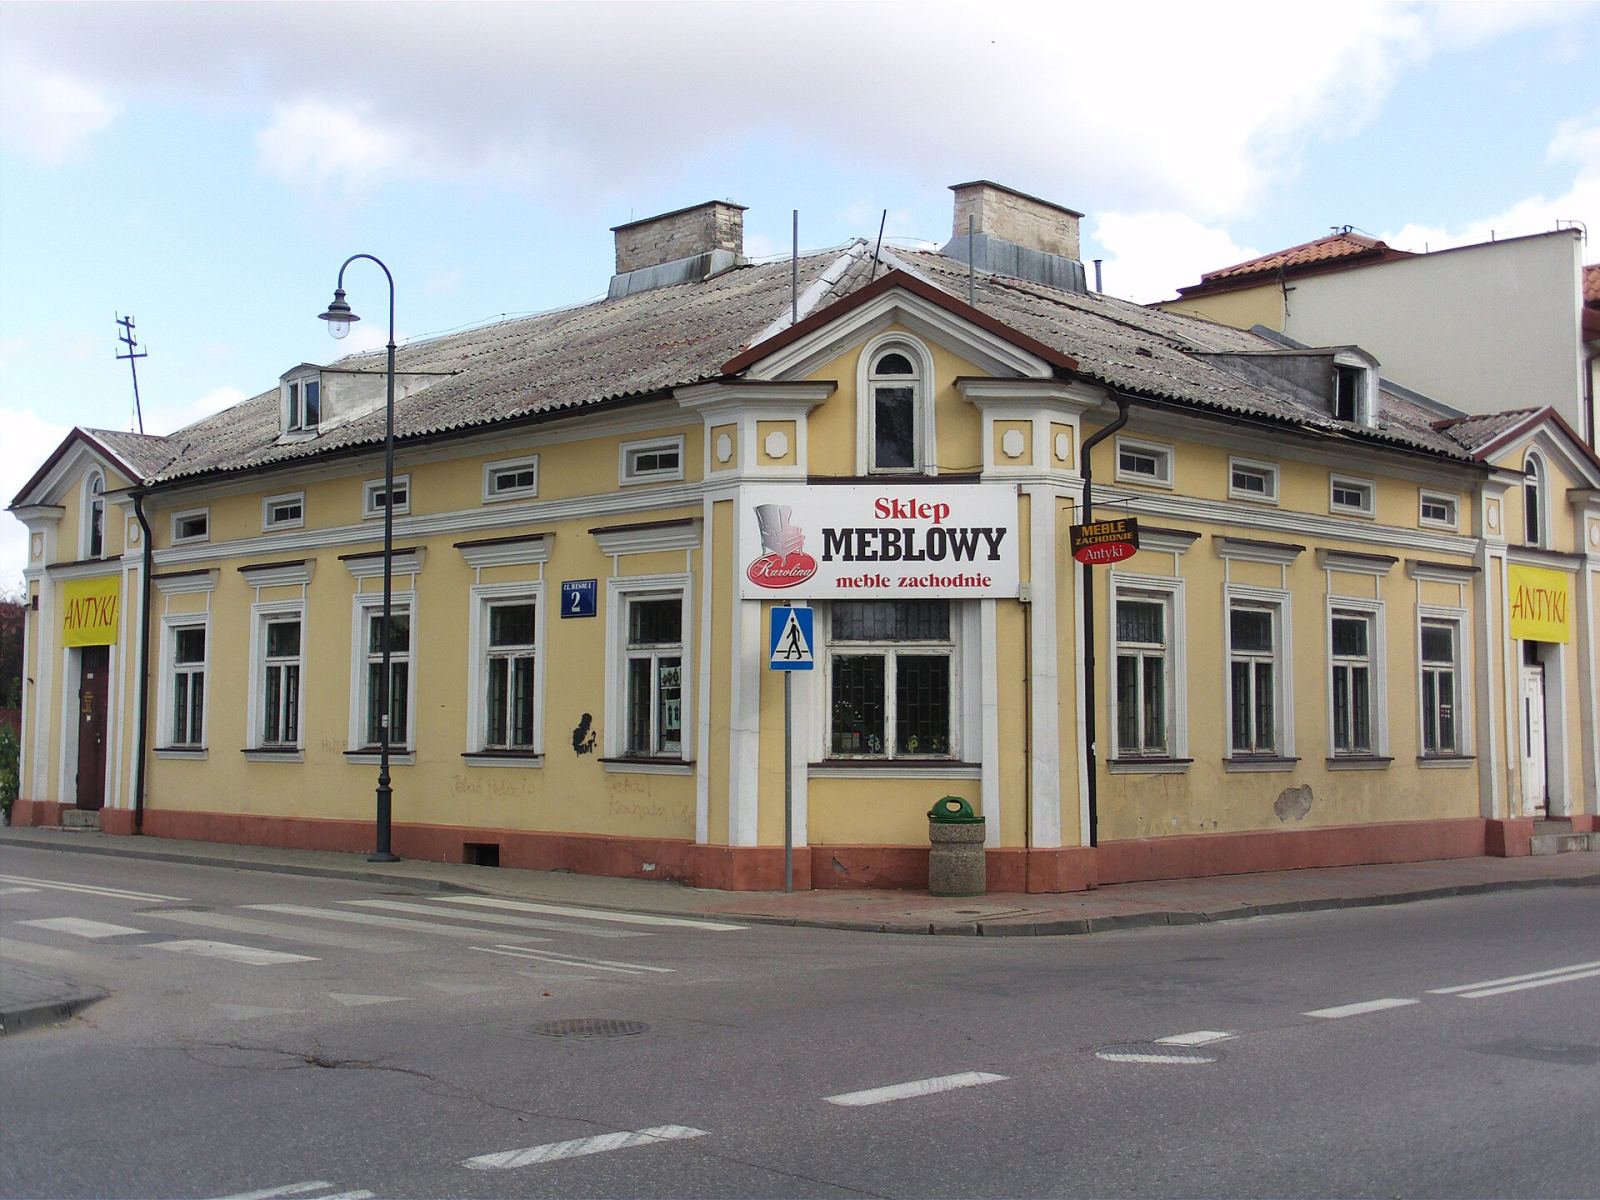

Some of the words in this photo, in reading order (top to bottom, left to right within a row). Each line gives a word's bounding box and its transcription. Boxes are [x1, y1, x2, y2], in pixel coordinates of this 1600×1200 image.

[874, 497, 950, 524] Sklep
[1075, 532, 1134, 546] ZACHODNIE
[1081, 520, 1126, 537] MEBLE
[821, 527, 1007, 562] MEBLOWY
[1085, 544, 1123, 562] Antyki
[751, 557, 812, 578] Karolina
[835, 572, 891, 588] meble
[897, 571, 992, 588] zachodnie
[63, 595, 117, 629] ANTYKI
[571, 591, 581, 613] 2
[1512, 585, 1566, 624] ANTYKI
